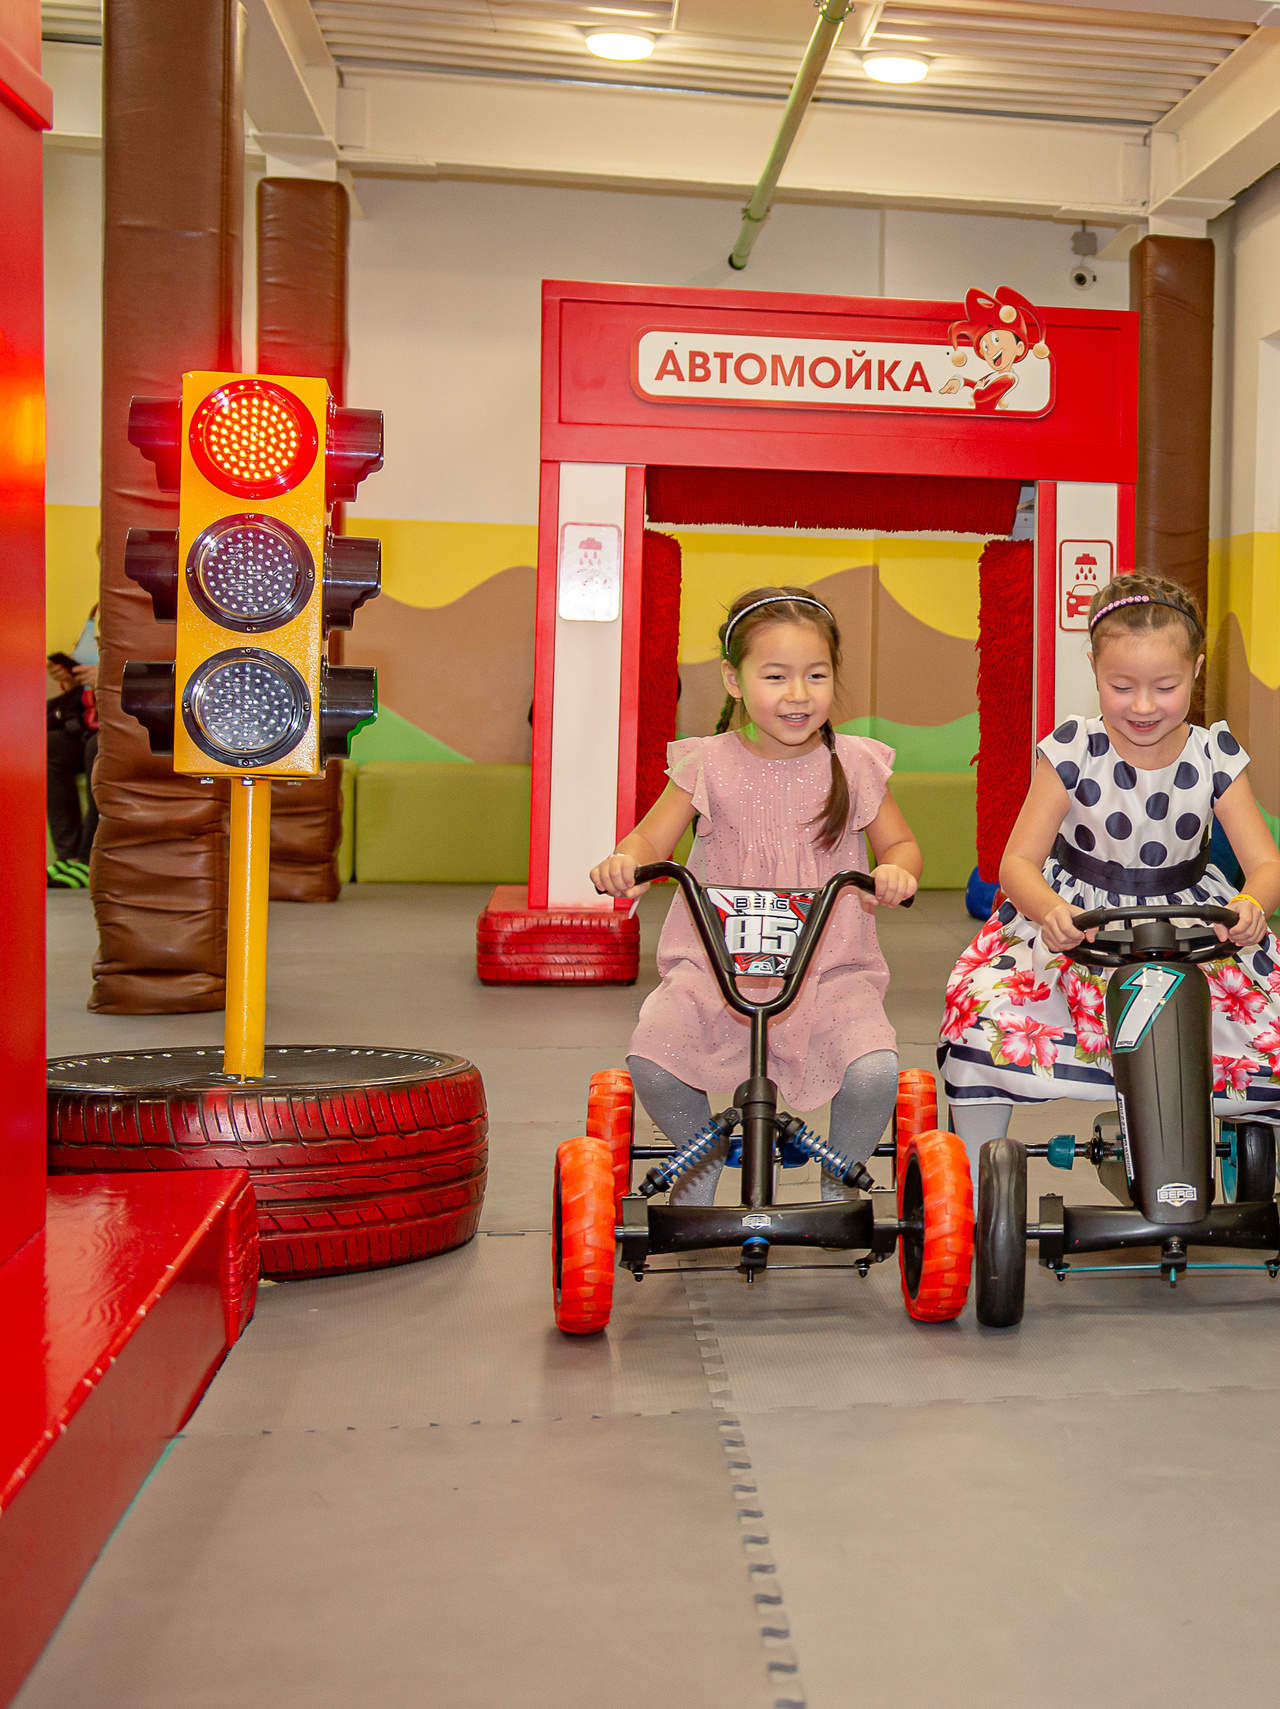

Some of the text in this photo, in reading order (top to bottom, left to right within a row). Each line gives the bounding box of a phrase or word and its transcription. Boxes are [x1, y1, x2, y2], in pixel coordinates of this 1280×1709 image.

[654, 348, 933, 393] АВТОМОЙКА
[735, 897, 789, 910] BERG
[724, 915, 799, 956] 85
[1160, 1190, 1195, 1199] BERG
